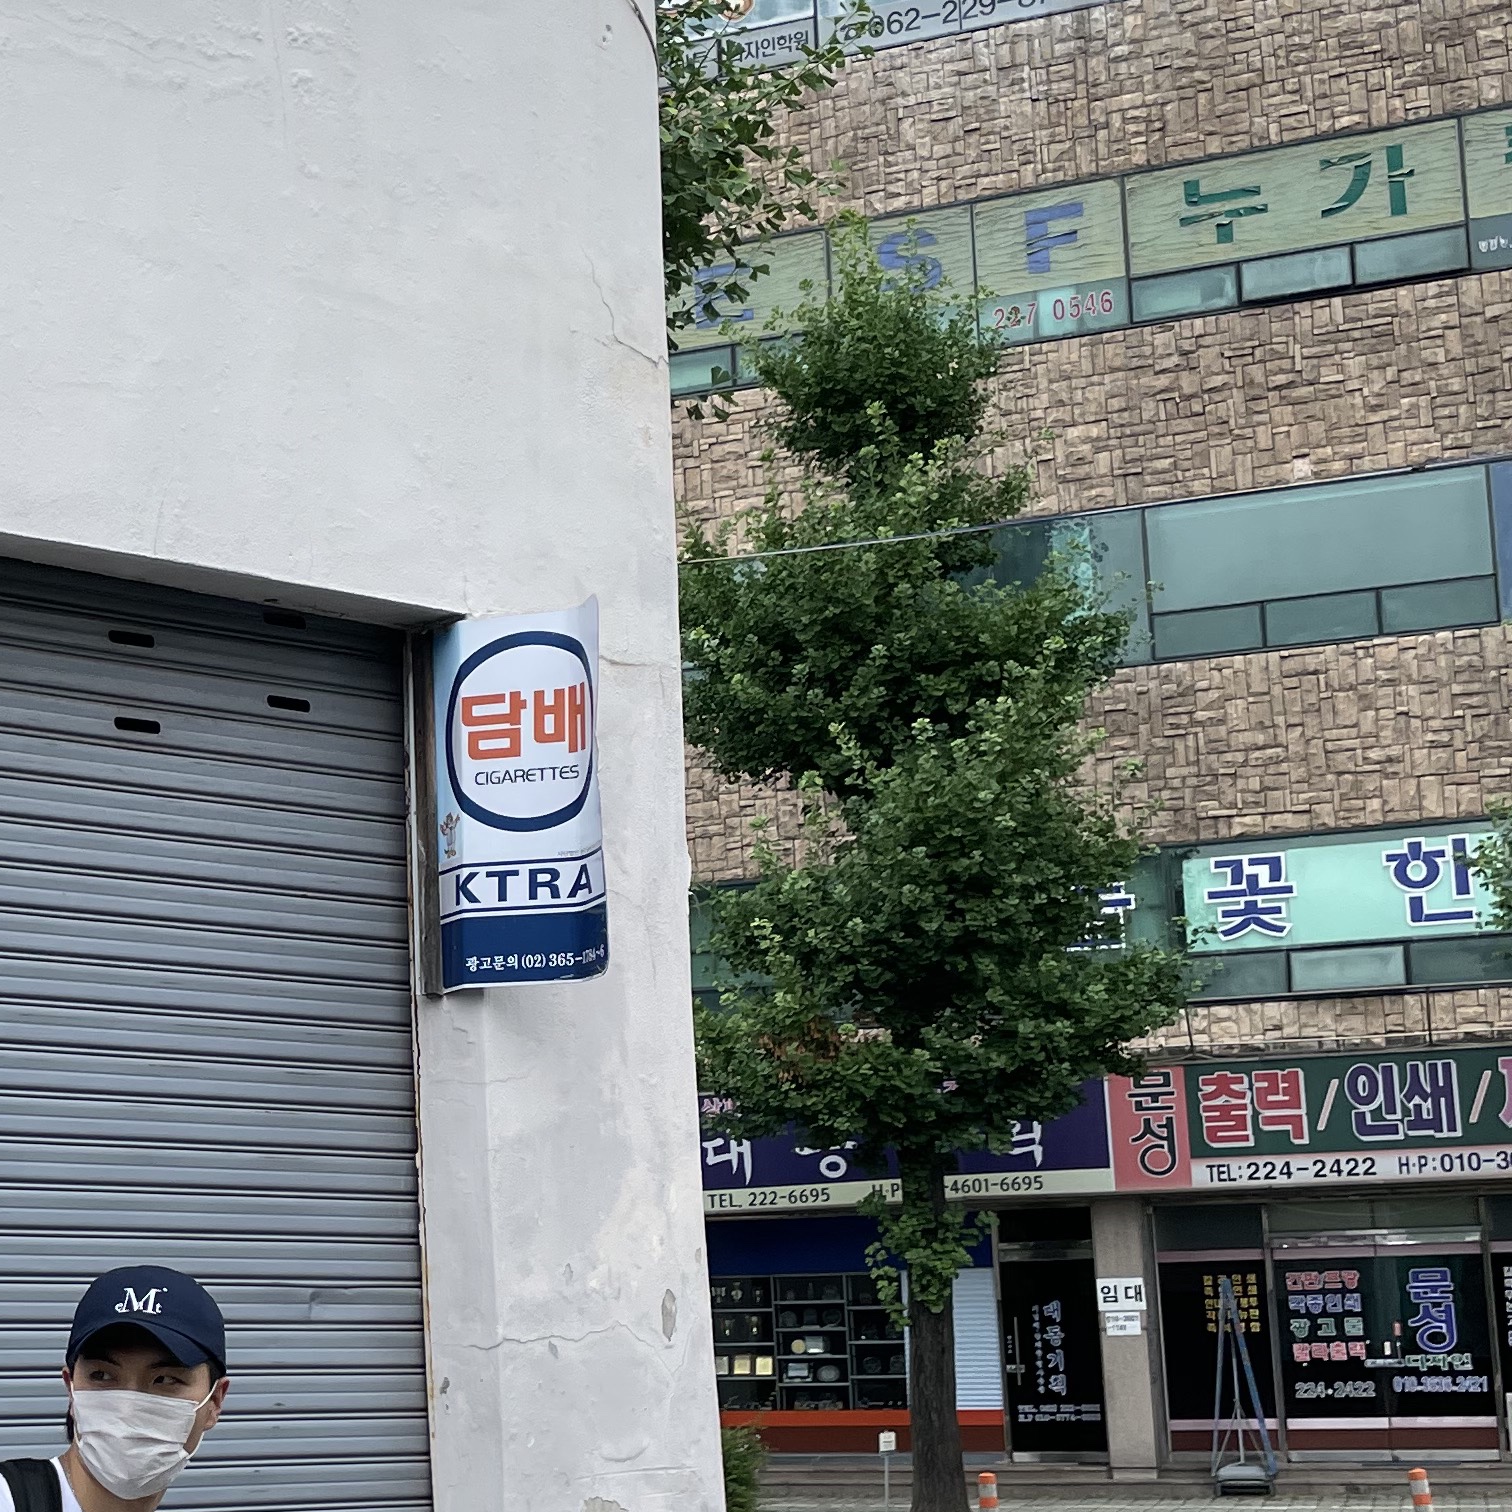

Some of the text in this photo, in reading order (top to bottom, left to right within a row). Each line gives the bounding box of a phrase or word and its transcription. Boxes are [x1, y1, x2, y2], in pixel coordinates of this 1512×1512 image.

[868, 0, 1045, 39] 062-229-
[1052, 290, 1114, 322] 0546
[461, 681, 587, 761] 담배
[474, 764, 580, 786] CIGARETTES
[455, 863, 593, 907] KTRA
[465, 954, 519, 972] 광고문의
[521, 952, 547, 970] (02)
[748, 1187, 831, 1207] 222-6695
[943, 1175, 1044, 1195] -4601-6695
[1406, 1267, 1458, 1353] 문성
